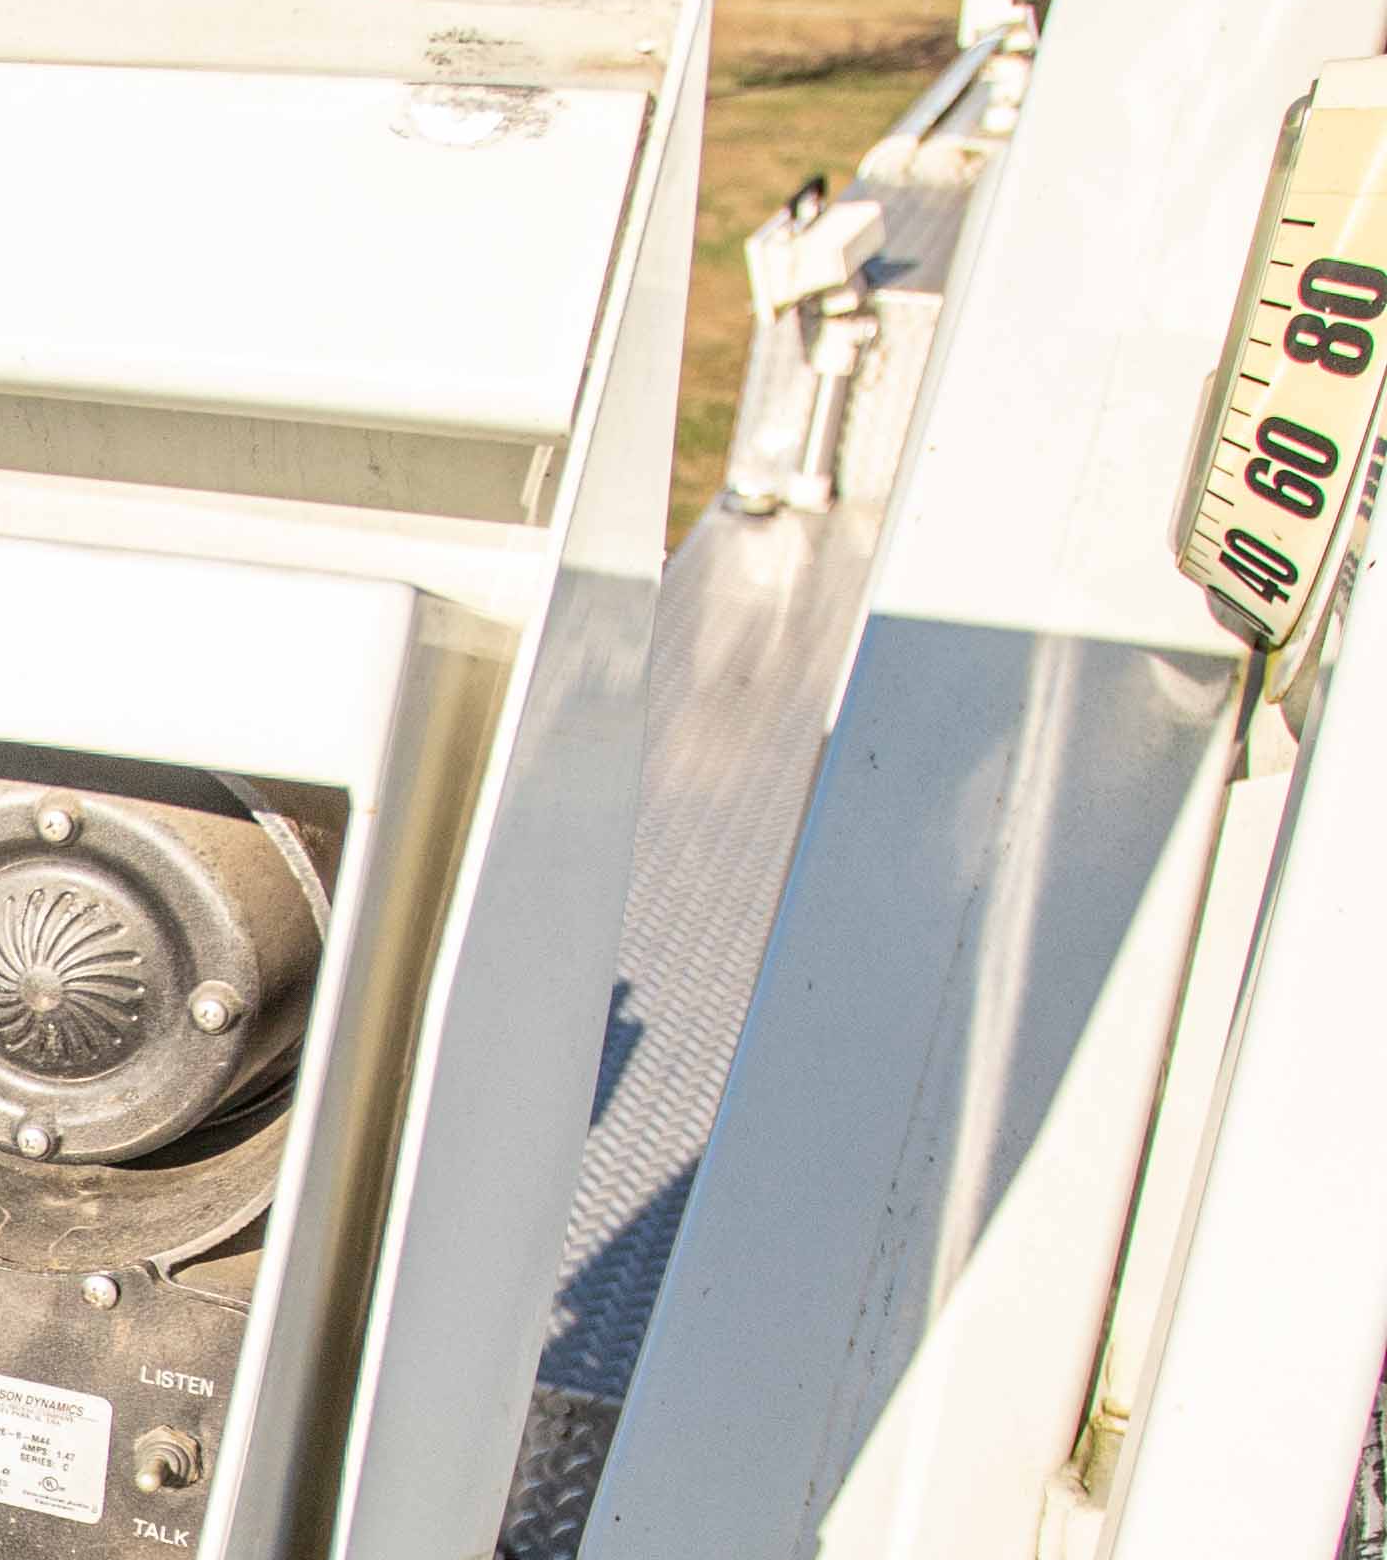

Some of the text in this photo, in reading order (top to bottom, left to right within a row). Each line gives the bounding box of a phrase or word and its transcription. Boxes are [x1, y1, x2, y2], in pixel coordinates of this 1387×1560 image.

[1284, 257, 1387, 377] 80
[1244, 416, 1341, 520] 60
[1218, 528, 1300, 604] 40
[25, 1394, 84, 1417] DYNAMICS
[139, 1365, 214, 1397] LISTEN
[133, 1517, 191, 1547] TALK
